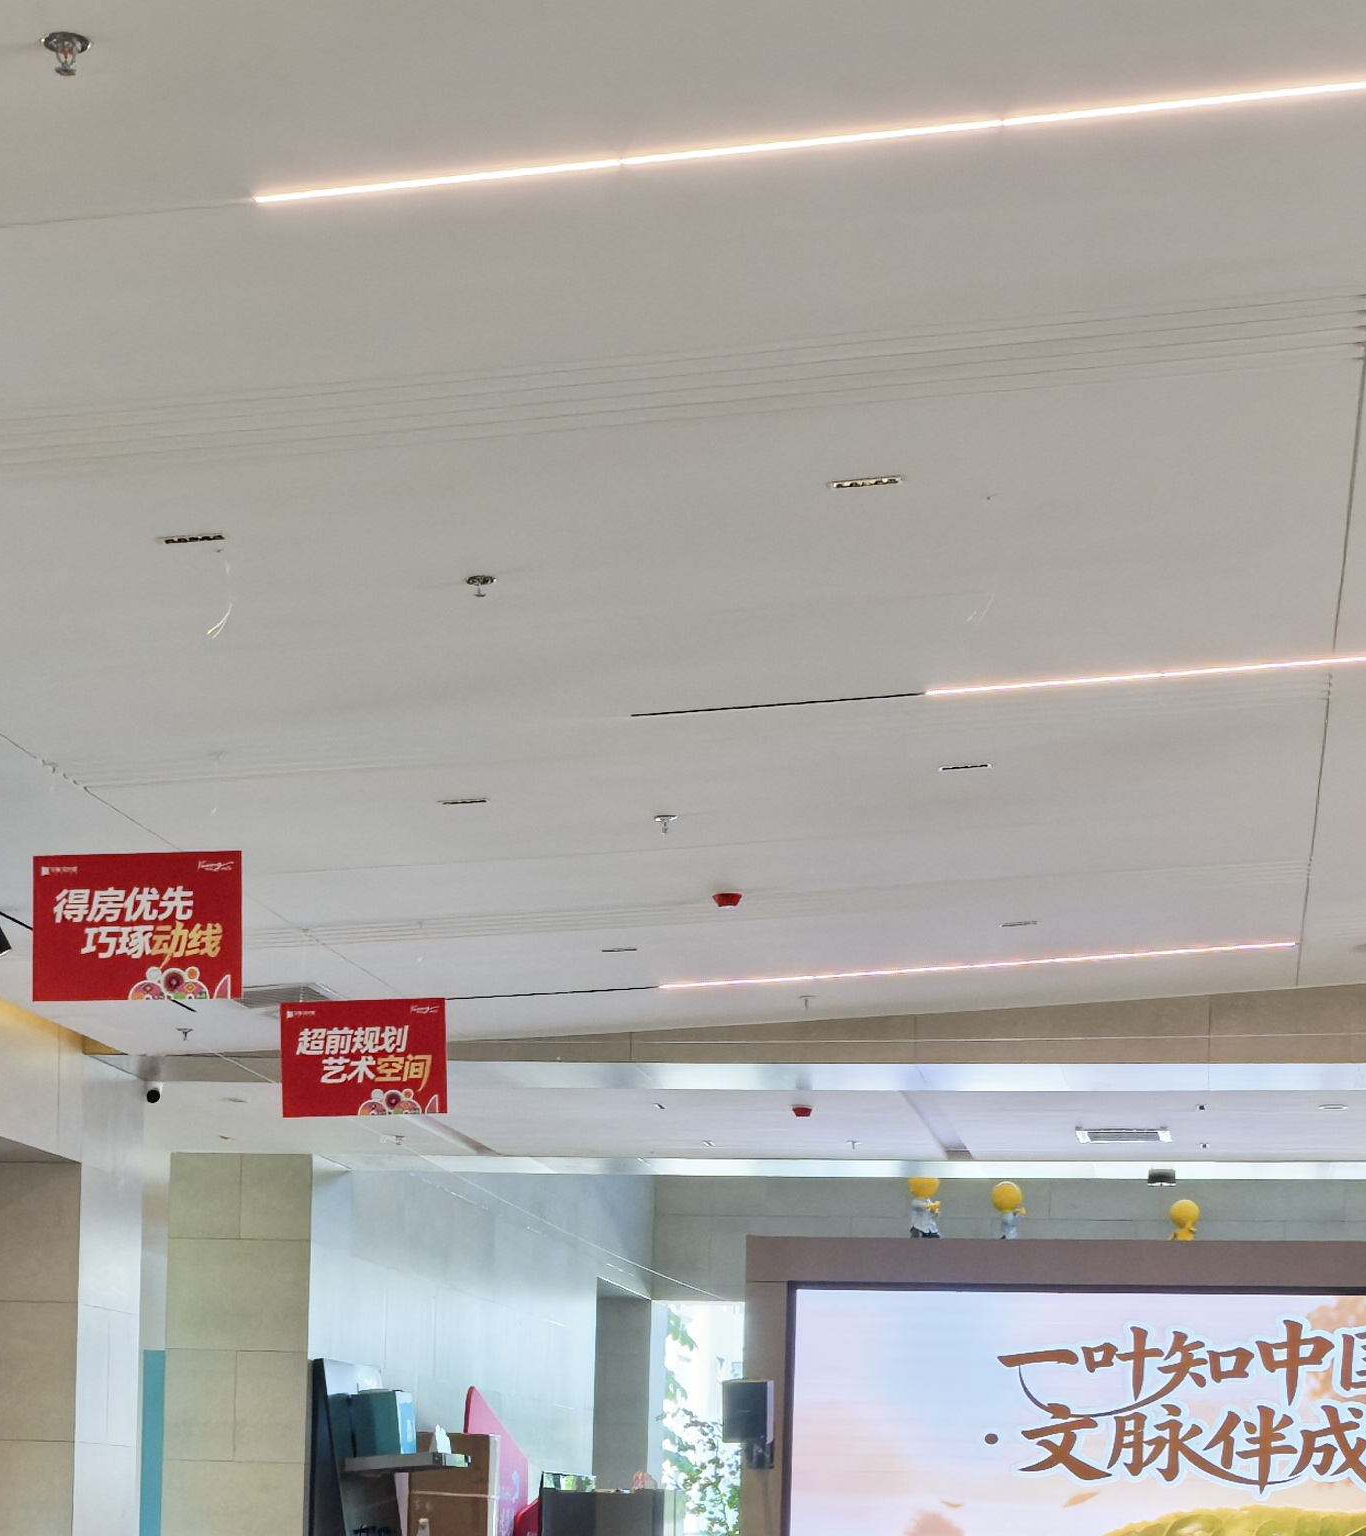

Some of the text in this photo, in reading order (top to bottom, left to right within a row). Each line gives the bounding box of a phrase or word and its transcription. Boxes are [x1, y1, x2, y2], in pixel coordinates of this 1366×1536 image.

[53, 885, 194, 923] 得房优先
[81, 921, 223, 969] 巧琢动线
[296, 1025, 409, 1056] 超前规划
[320, 1054, 432, 1092] 艺术空间
